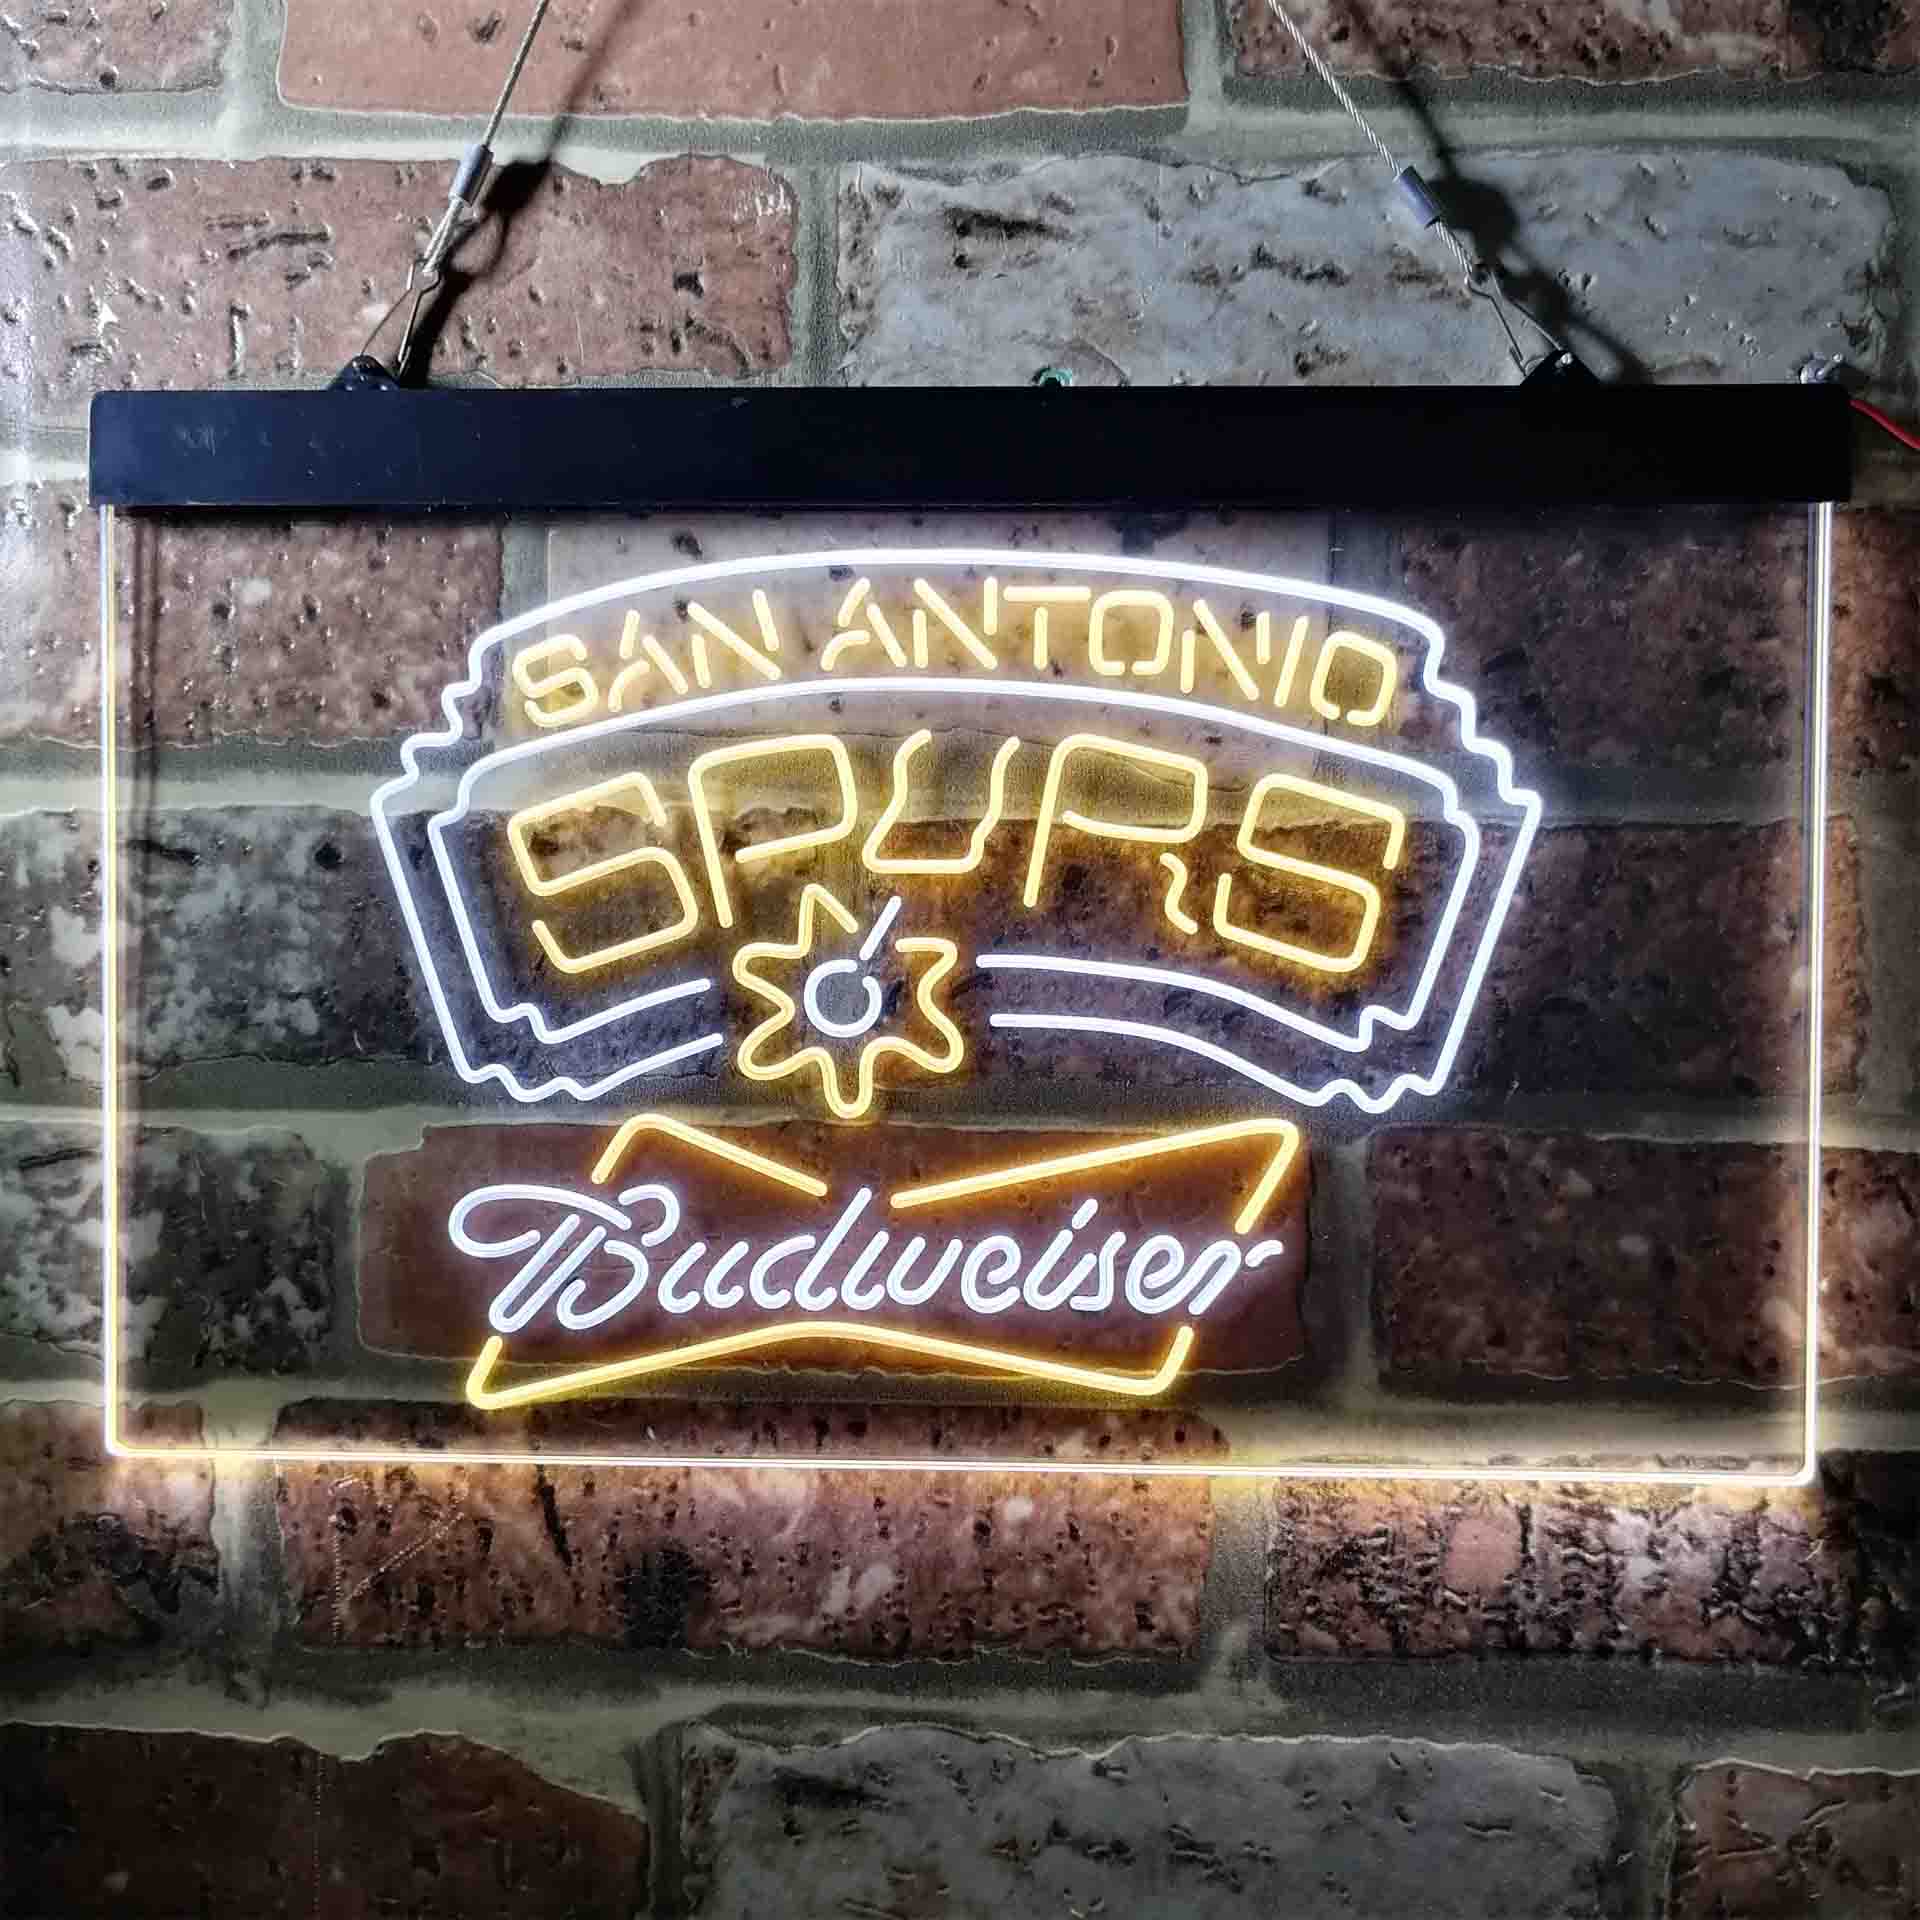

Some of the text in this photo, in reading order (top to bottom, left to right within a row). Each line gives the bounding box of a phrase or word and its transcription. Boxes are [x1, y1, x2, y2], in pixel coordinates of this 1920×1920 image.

[512, 576, 1397, 728] SAN ANTONIO
[507, 729, 1405, 974] SPURS
[448, 1183, 1284, 1334] Budweiser
